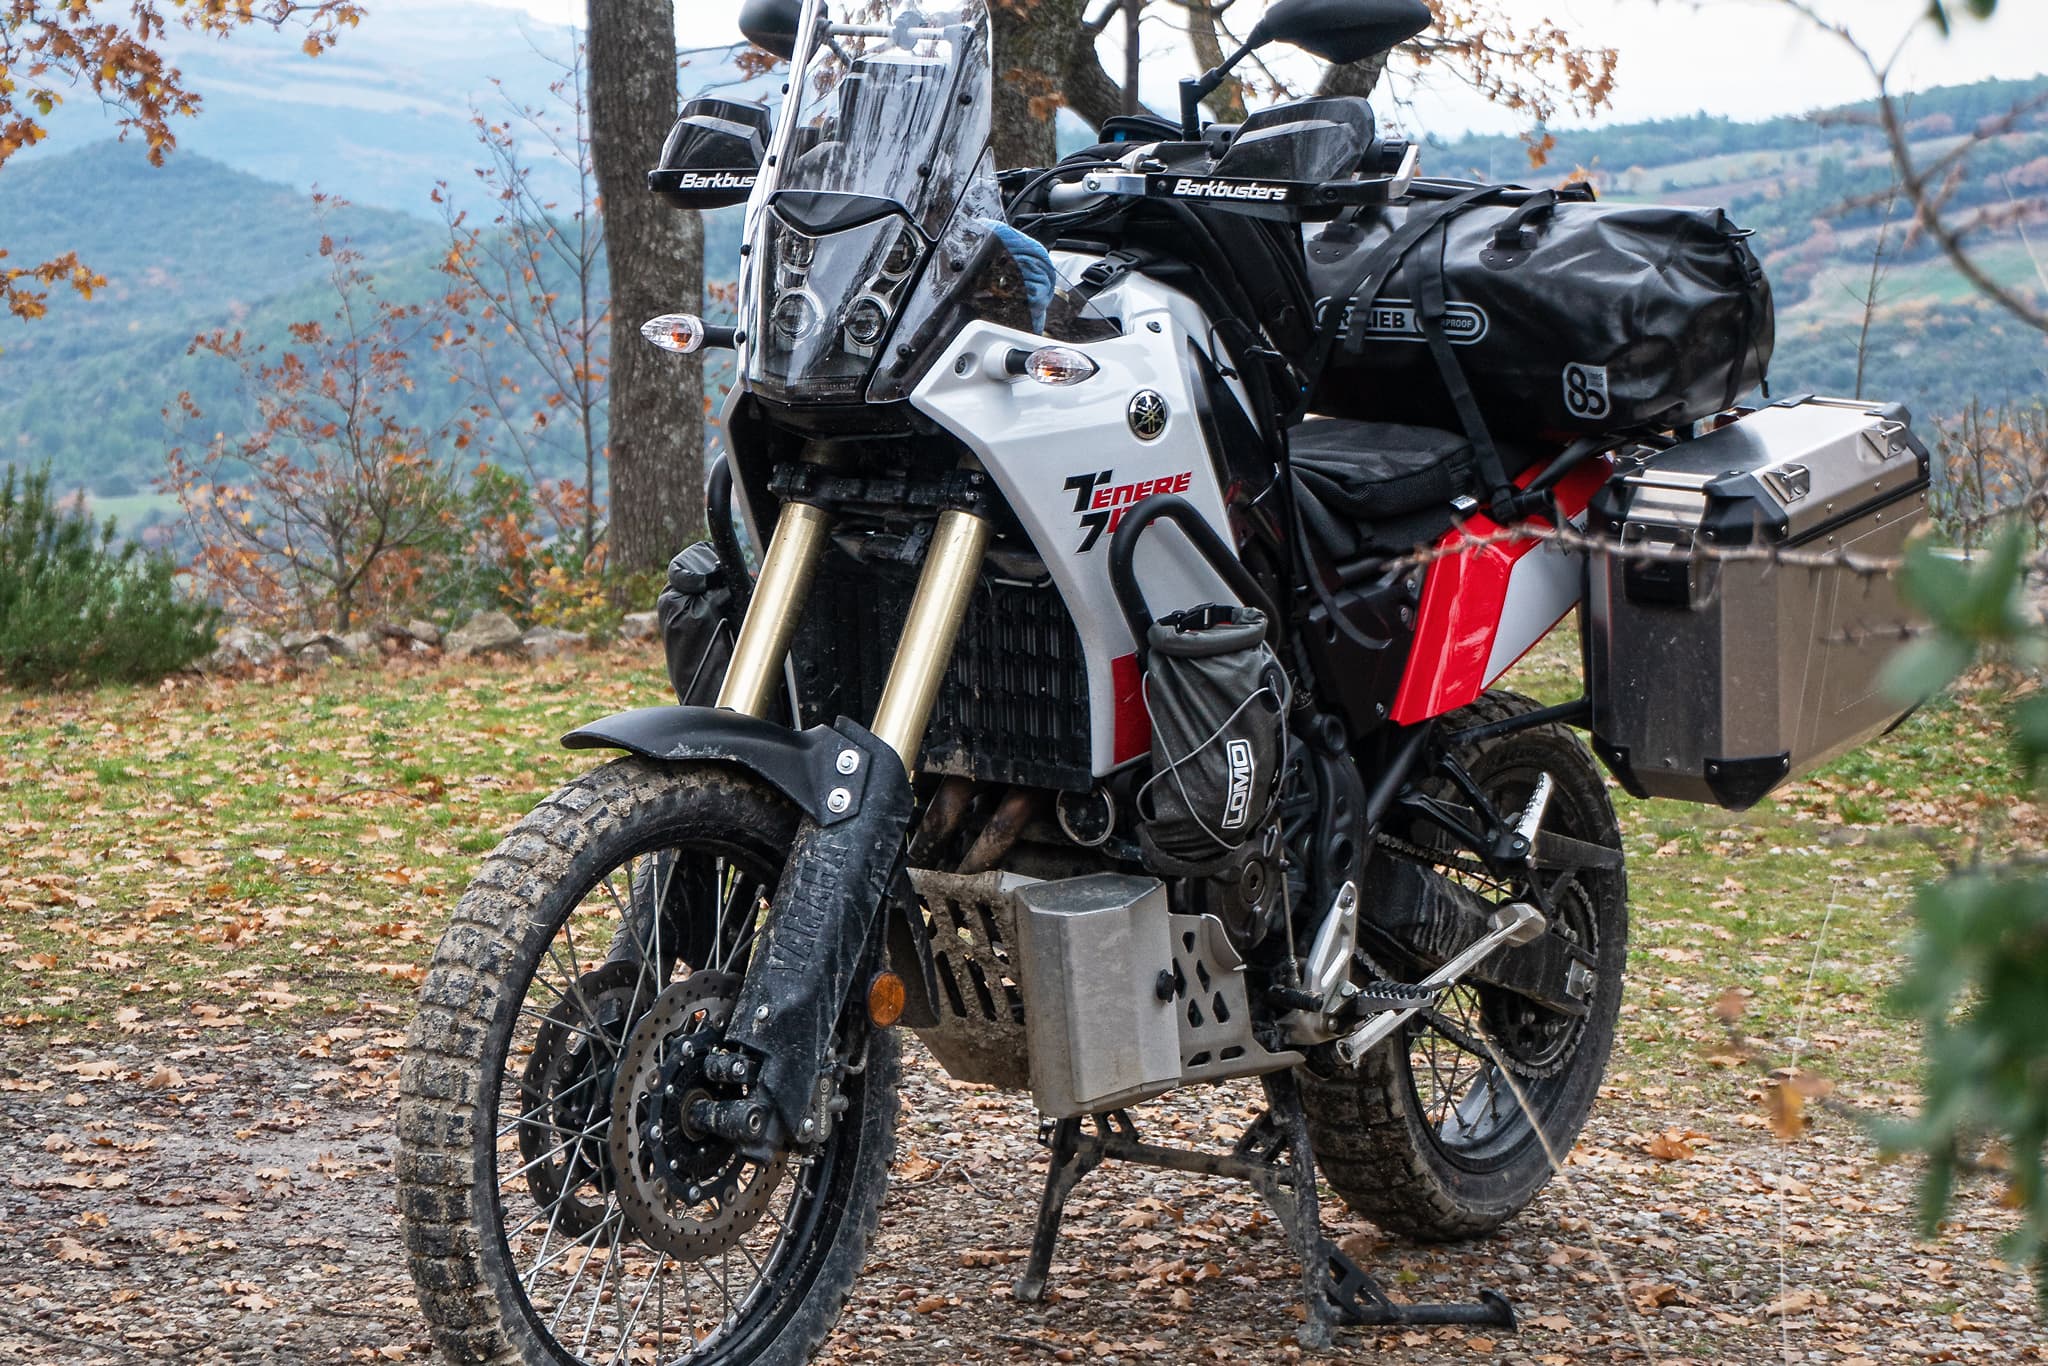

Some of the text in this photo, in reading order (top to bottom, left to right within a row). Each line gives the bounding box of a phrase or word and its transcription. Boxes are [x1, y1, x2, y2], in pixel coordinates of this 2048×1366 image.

[680, 172, 758, 189] Barkbus
[1173, 179, 1289, 201] Barkbusters
[1226, 744, 1250, 826] LOMO
[770, 845, 849, 974] YAMAHA
